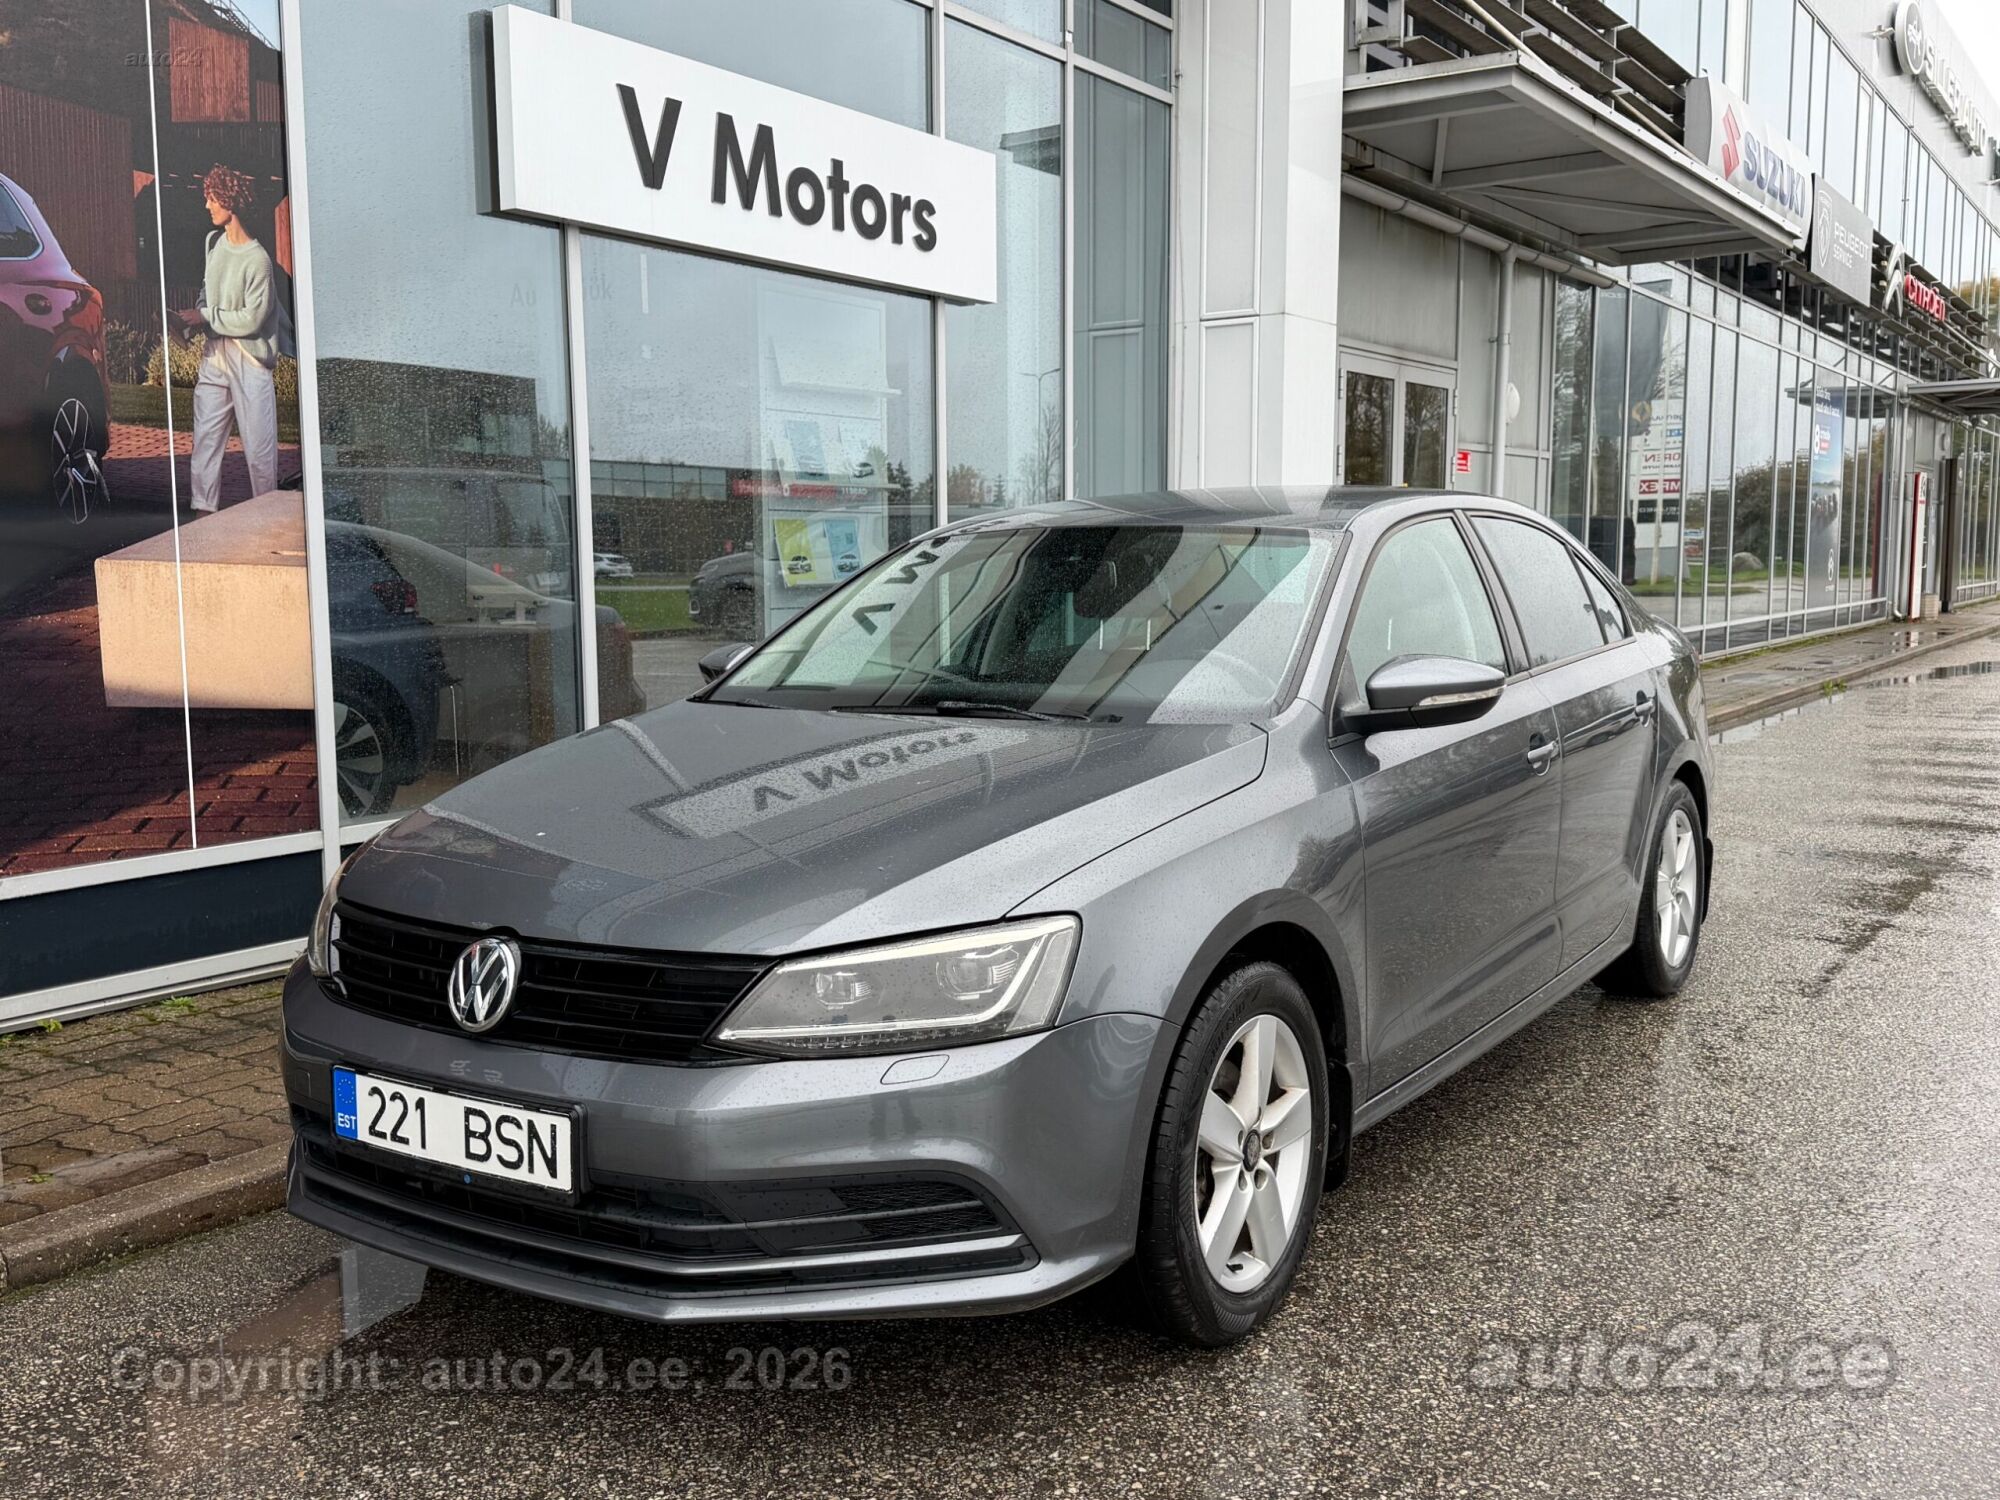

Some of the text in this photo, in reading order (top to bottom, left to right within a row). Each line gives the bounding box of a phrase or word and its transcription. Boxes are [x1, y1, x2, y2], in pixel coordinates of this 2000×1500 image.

[616, 83, 937, 252] V Motors
[1743, 130, 1806, 219] SUZUKI
[1834, 221, 1869, 261] PEUGEOT
[337, 1112, 356, 1131] EST
[368, 1086, 558, 1179] 221 BSN
